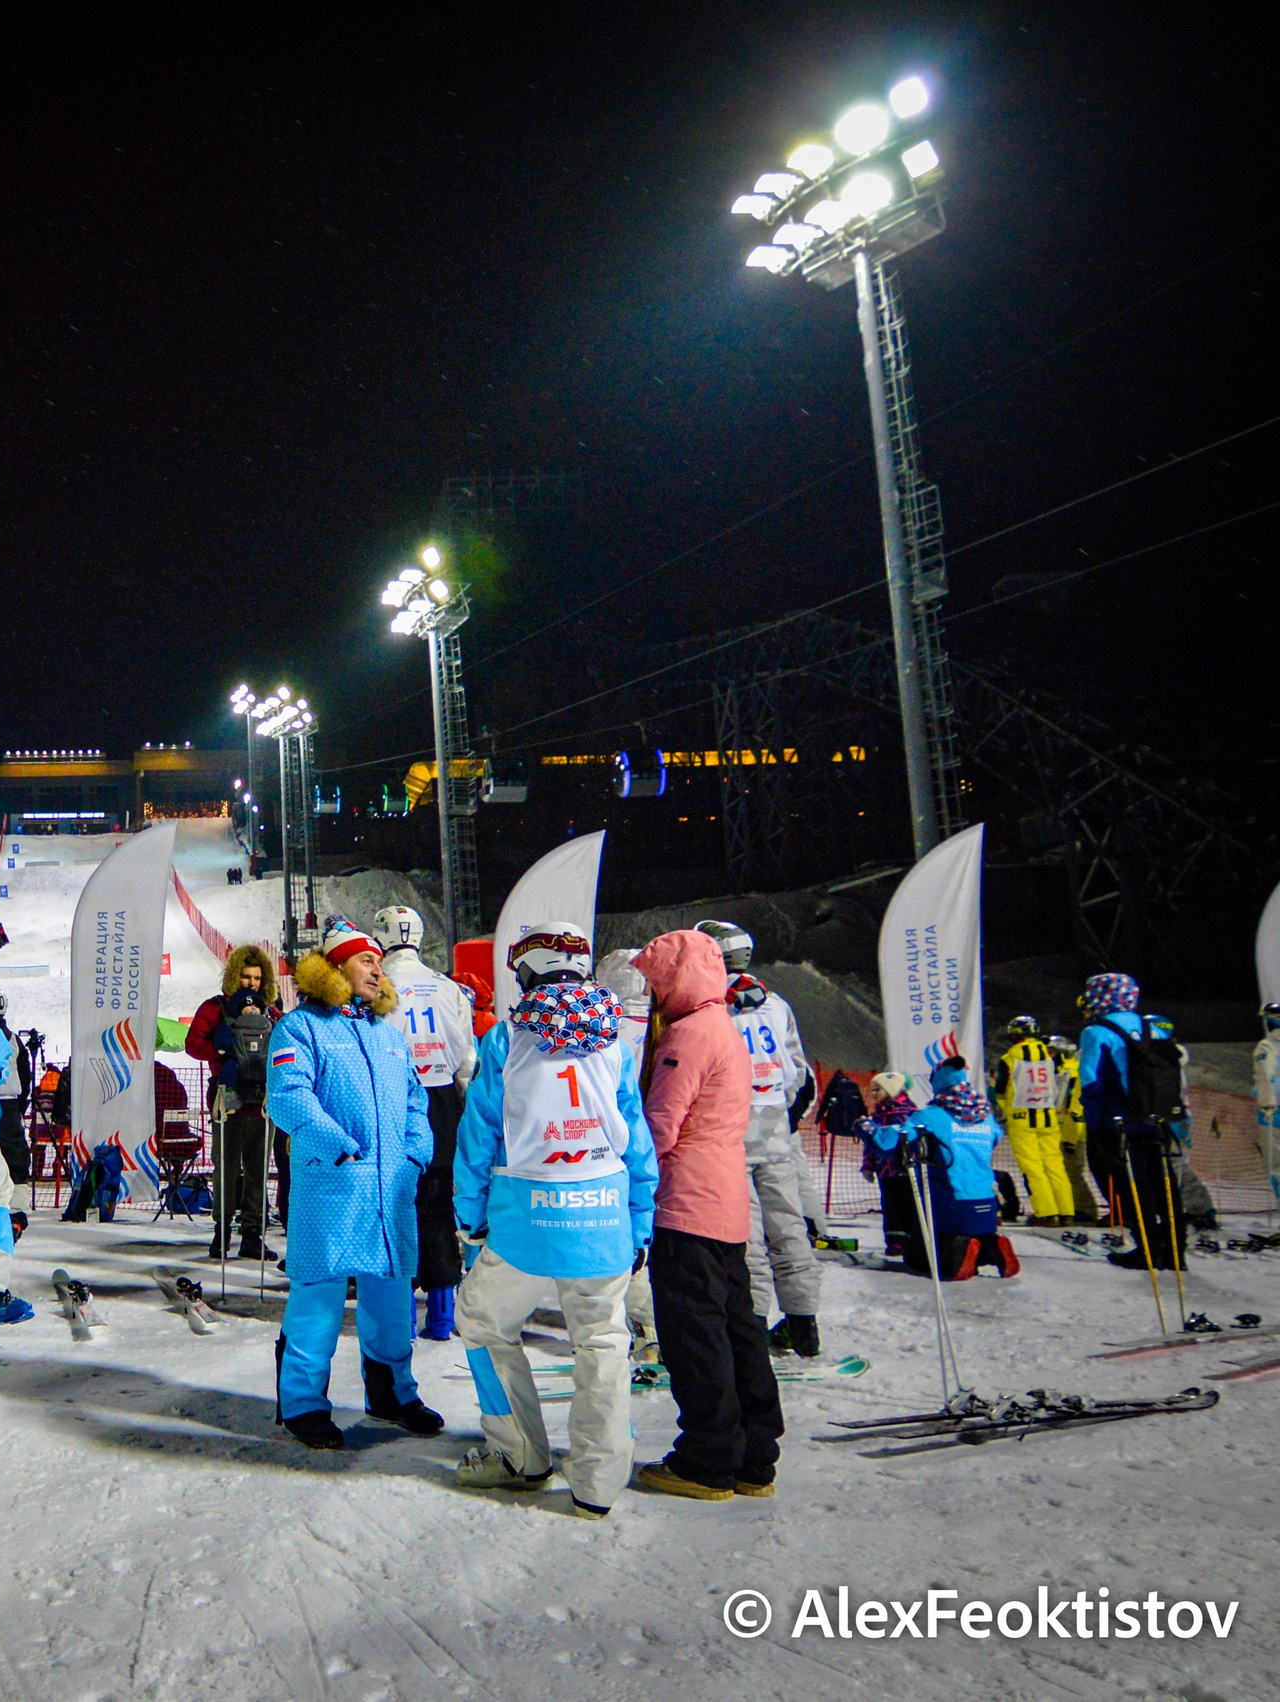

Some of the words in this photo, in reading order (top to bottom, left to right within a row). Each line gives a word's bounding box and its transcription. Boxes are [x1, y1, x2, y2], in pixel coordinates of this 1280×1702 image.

[95, 911, 110, 1009] ФЕДЕРАЦИЯ
[111, 910, 126, 1010] ФРИСТАЙЛА
[923, 924, 943, 1024] ФРИСТАЙЛА
[127, 945, 140, 1010] РОССИИ
[905, 928, 924, 1026] ФЕДЕРАЦИЯ
[945, 958, 961, 1023] РОССИИ
[246, 995, 253, 1004] S
[404, 1006, 436, 1034] 11
[742, 1025, 777, 1055] 13
[557, 1065, 580, 1108] 1
[1027, 1067, 1049, 1083] 15
[563, 1129, 587, 1140] СПОРТ
[591, 1146, 610, 1155] НОВАЯ
[591, 1153, 605, 1161] ЛИГА
[531, 1186, 620, 1210] RUSSIA
[531, 1219, 581, 1228] FREESTYLE
[583, 1219, 597, 1228] SKI
[599, 1218, 620, 1227] TEAM
